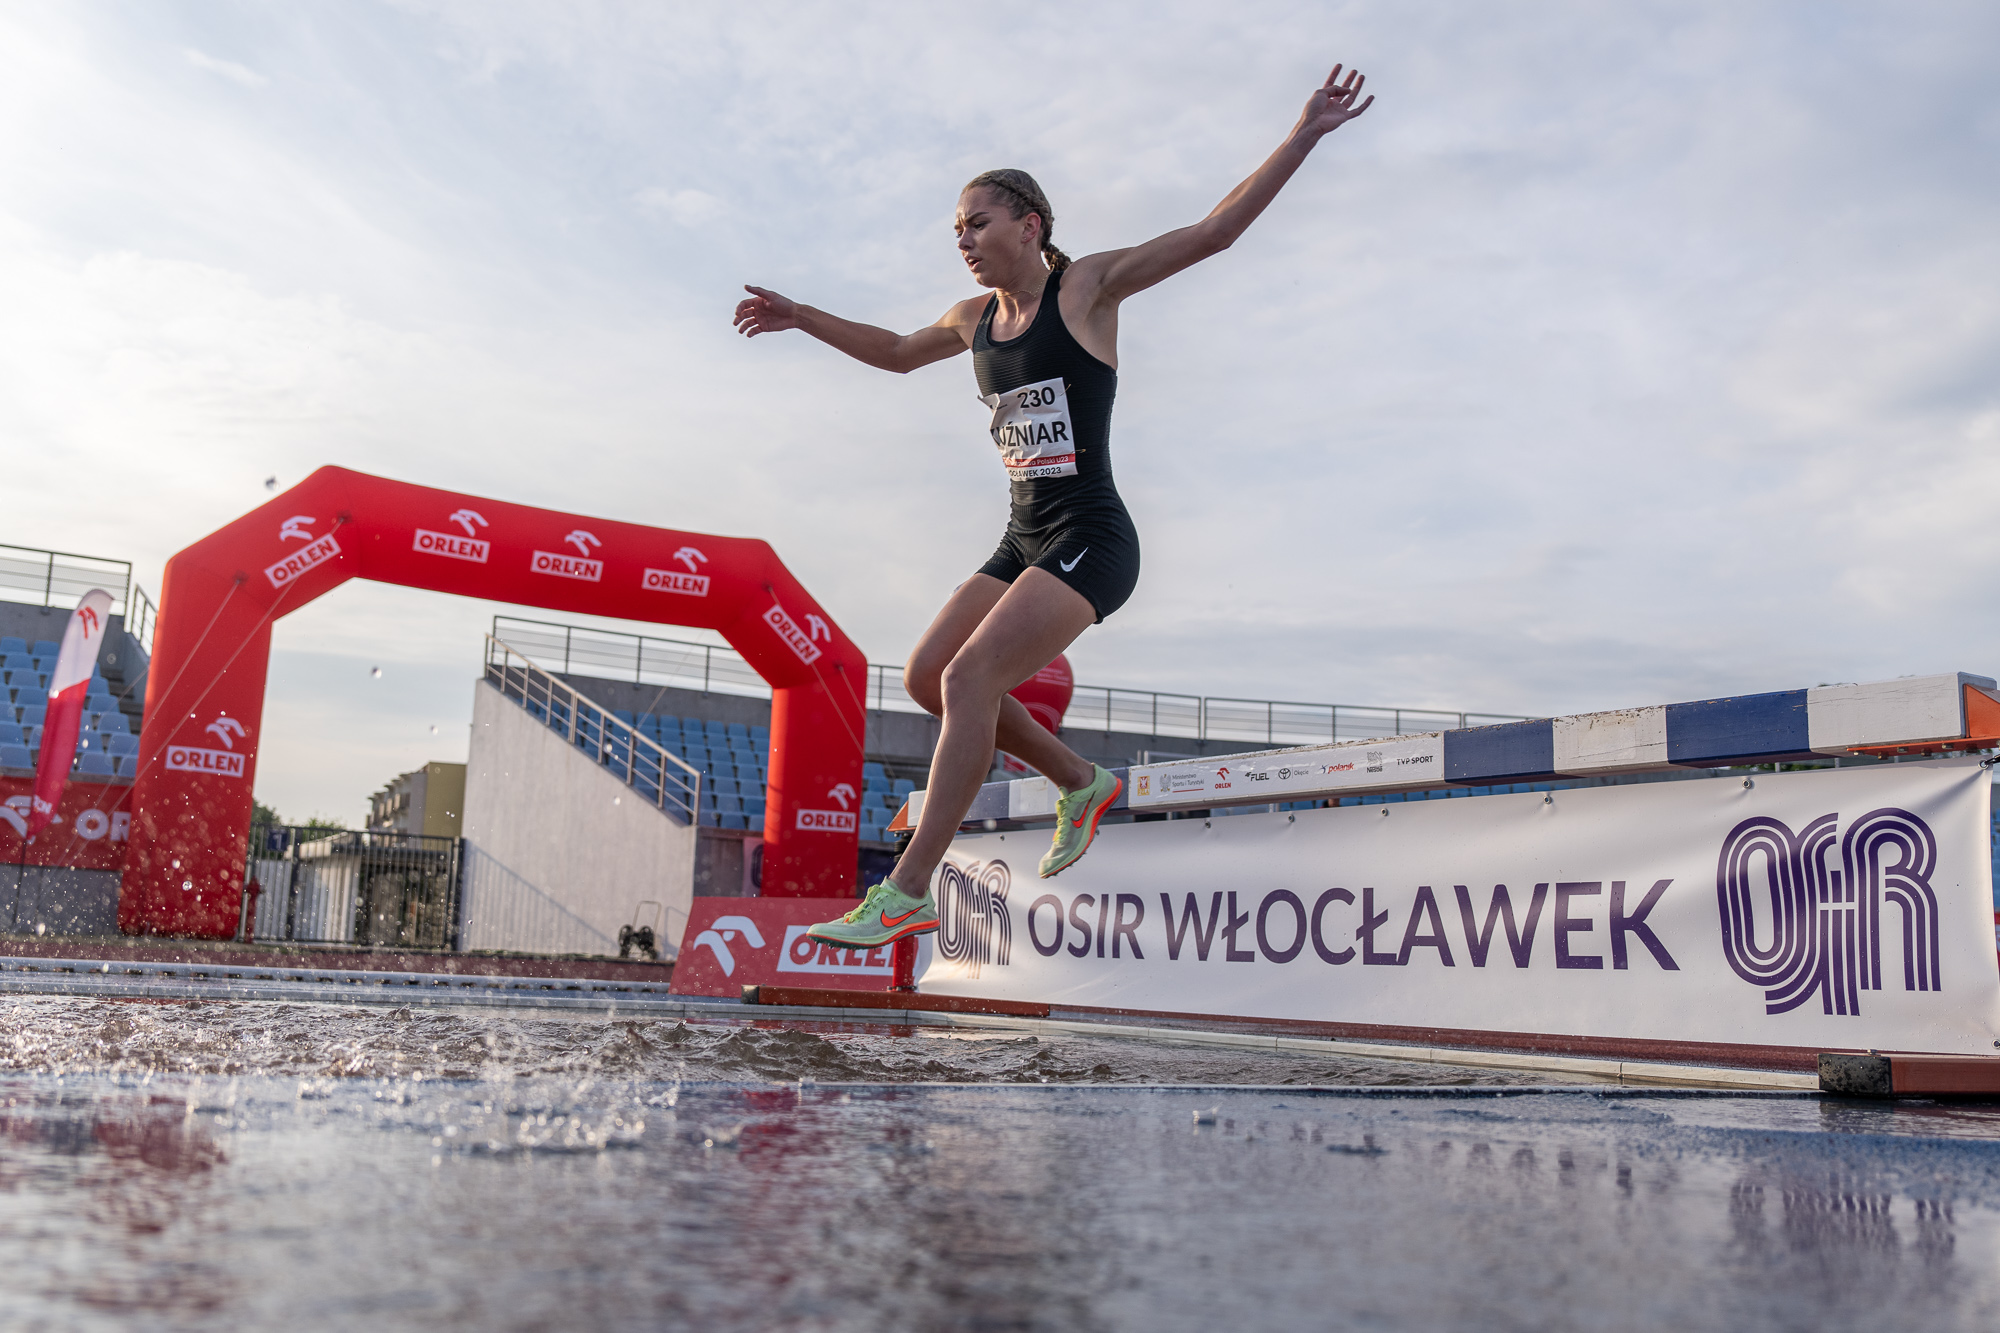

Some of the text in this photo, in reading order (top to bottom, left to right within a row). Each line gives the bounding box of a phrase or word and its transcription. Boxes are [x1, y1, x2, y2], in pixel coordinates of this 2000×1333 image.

[1017, 386, 1055, 409] 230
[1039, 466, 1062, 476] 2023
[418, 534, 486, 558] ORLEN
[272, 537, 337, 583] ORLEN
[536, 556, 599, 579] ORLEN
[648, 572, 706, 594] ORLEN
[770, 610, 816, 661] ORLEN
[171, 750, 242, 773] ORLEN
[1328, 762, 1355, 775] polanik
[1396, 755, 1434, 766] TVP SPORT
[1250, 772, 1270, 782] FUEL
[800, 812, 853, 829] ORLEN
[1027, 878, 1681, 972] OSIR WŁOCŁAWEK
